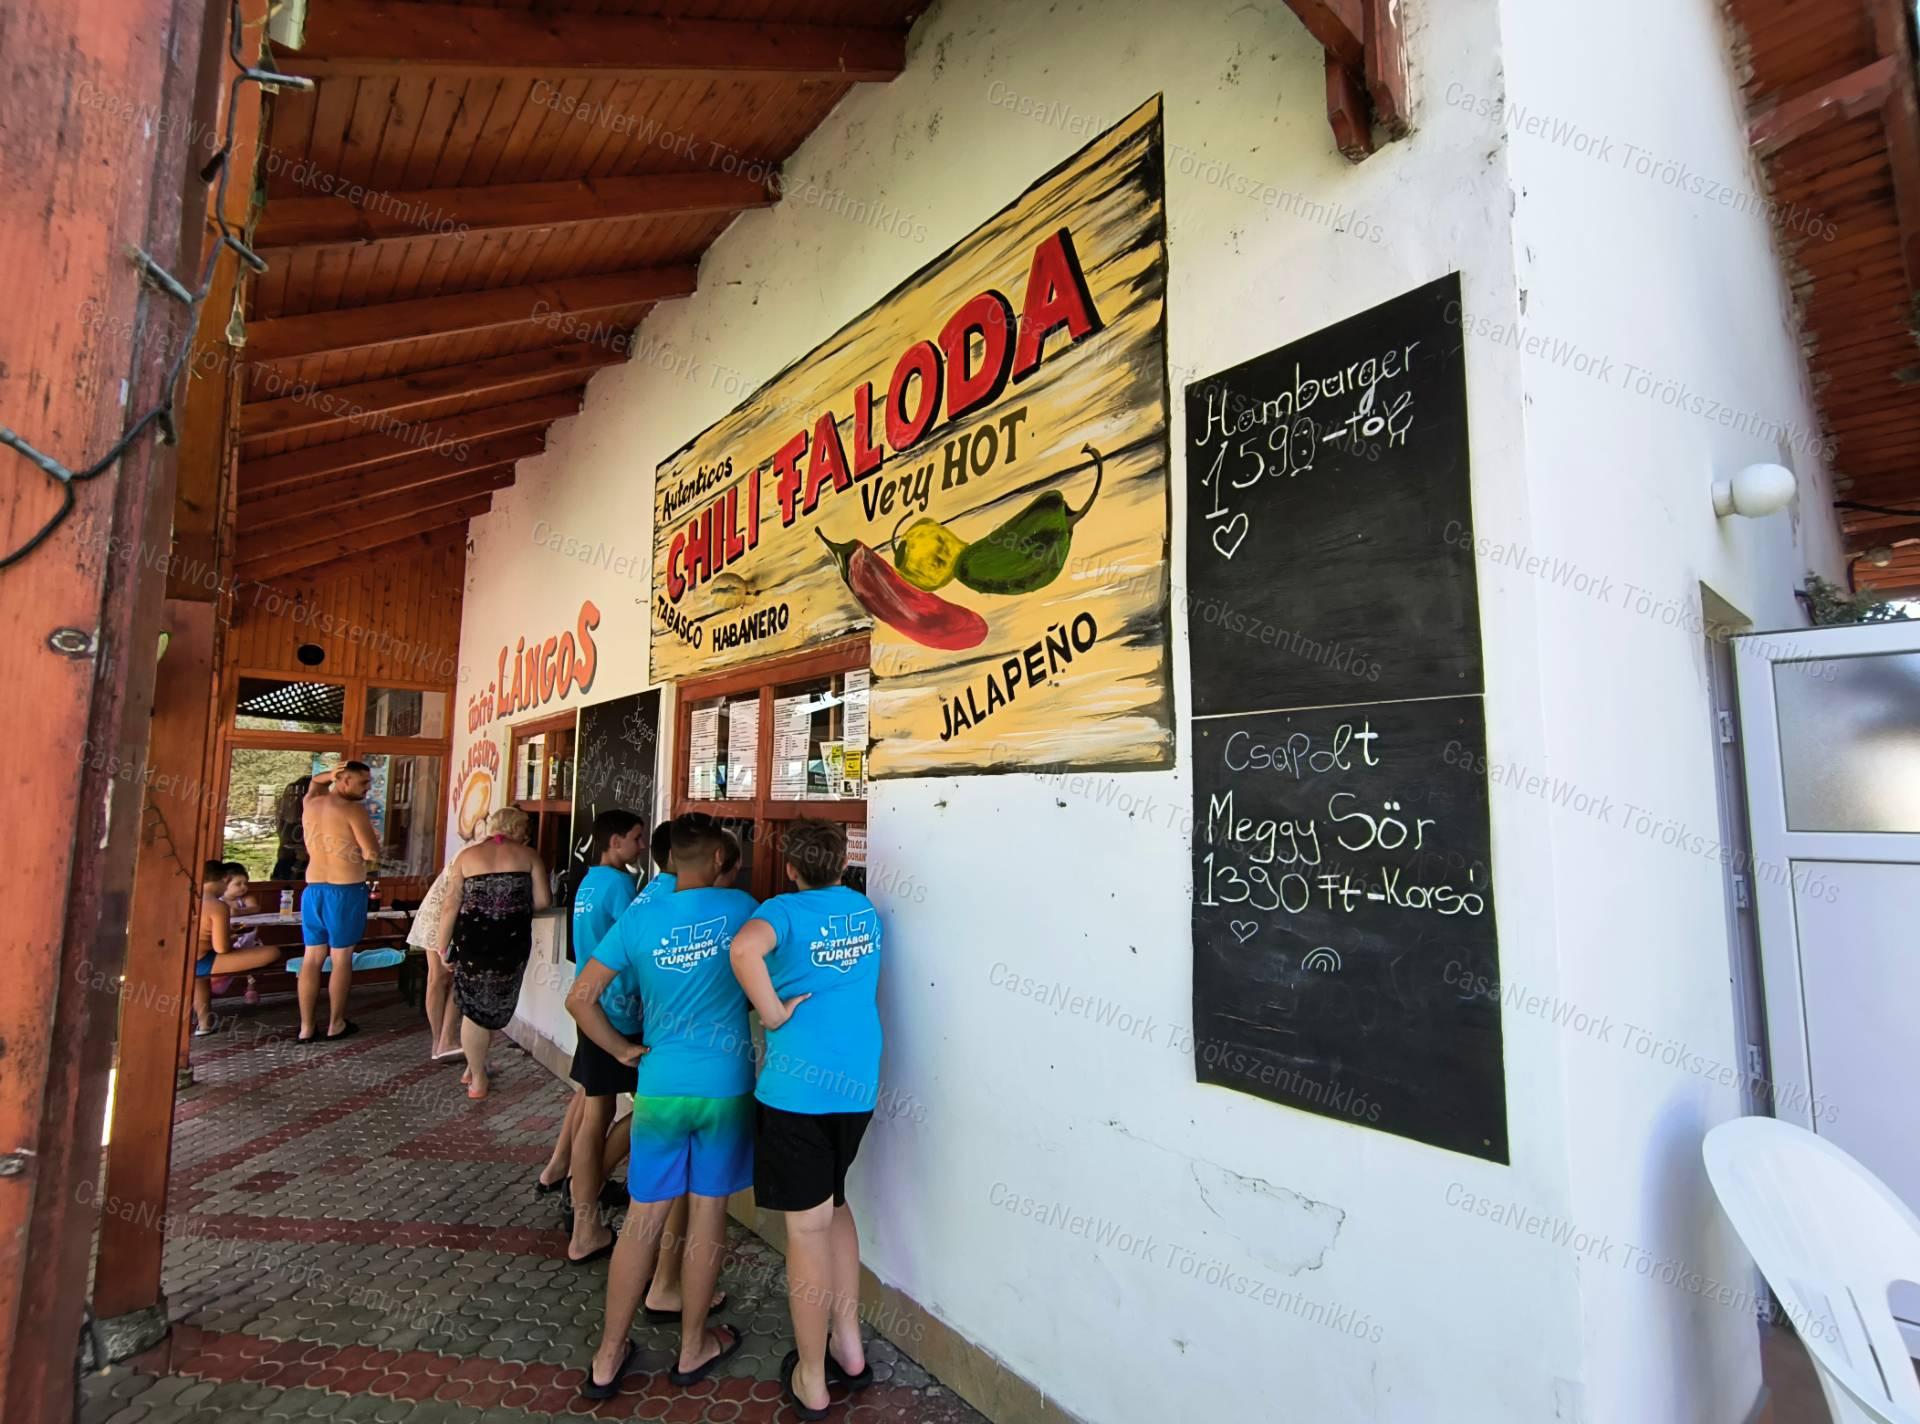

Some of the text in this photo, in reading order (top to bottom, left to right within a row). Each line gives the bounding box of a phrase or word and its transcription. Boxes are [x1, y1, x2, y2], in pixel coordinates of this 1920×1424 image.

[667, 226, 1105, 604] CHILI FALODA
[1195, 340, 1421, 447] Hamburger
[662, 455, 733, 522] Autenticos
[862, 407, 1027, 521] Very HOT
[656, 596, 704, 650] TABASCO
[712, 602, 790, 653] HABANERO
[496, 600, 600, 719] LÁNGOS
[940, 612, 1098, 741] JALAPEÑO
[1207, 789, 1436, 865] Meggy Sör
[1200, 852, 1309, 914] 1390
[671, 915, 727, 946] 17
[828, 907, 877, 940] 17
